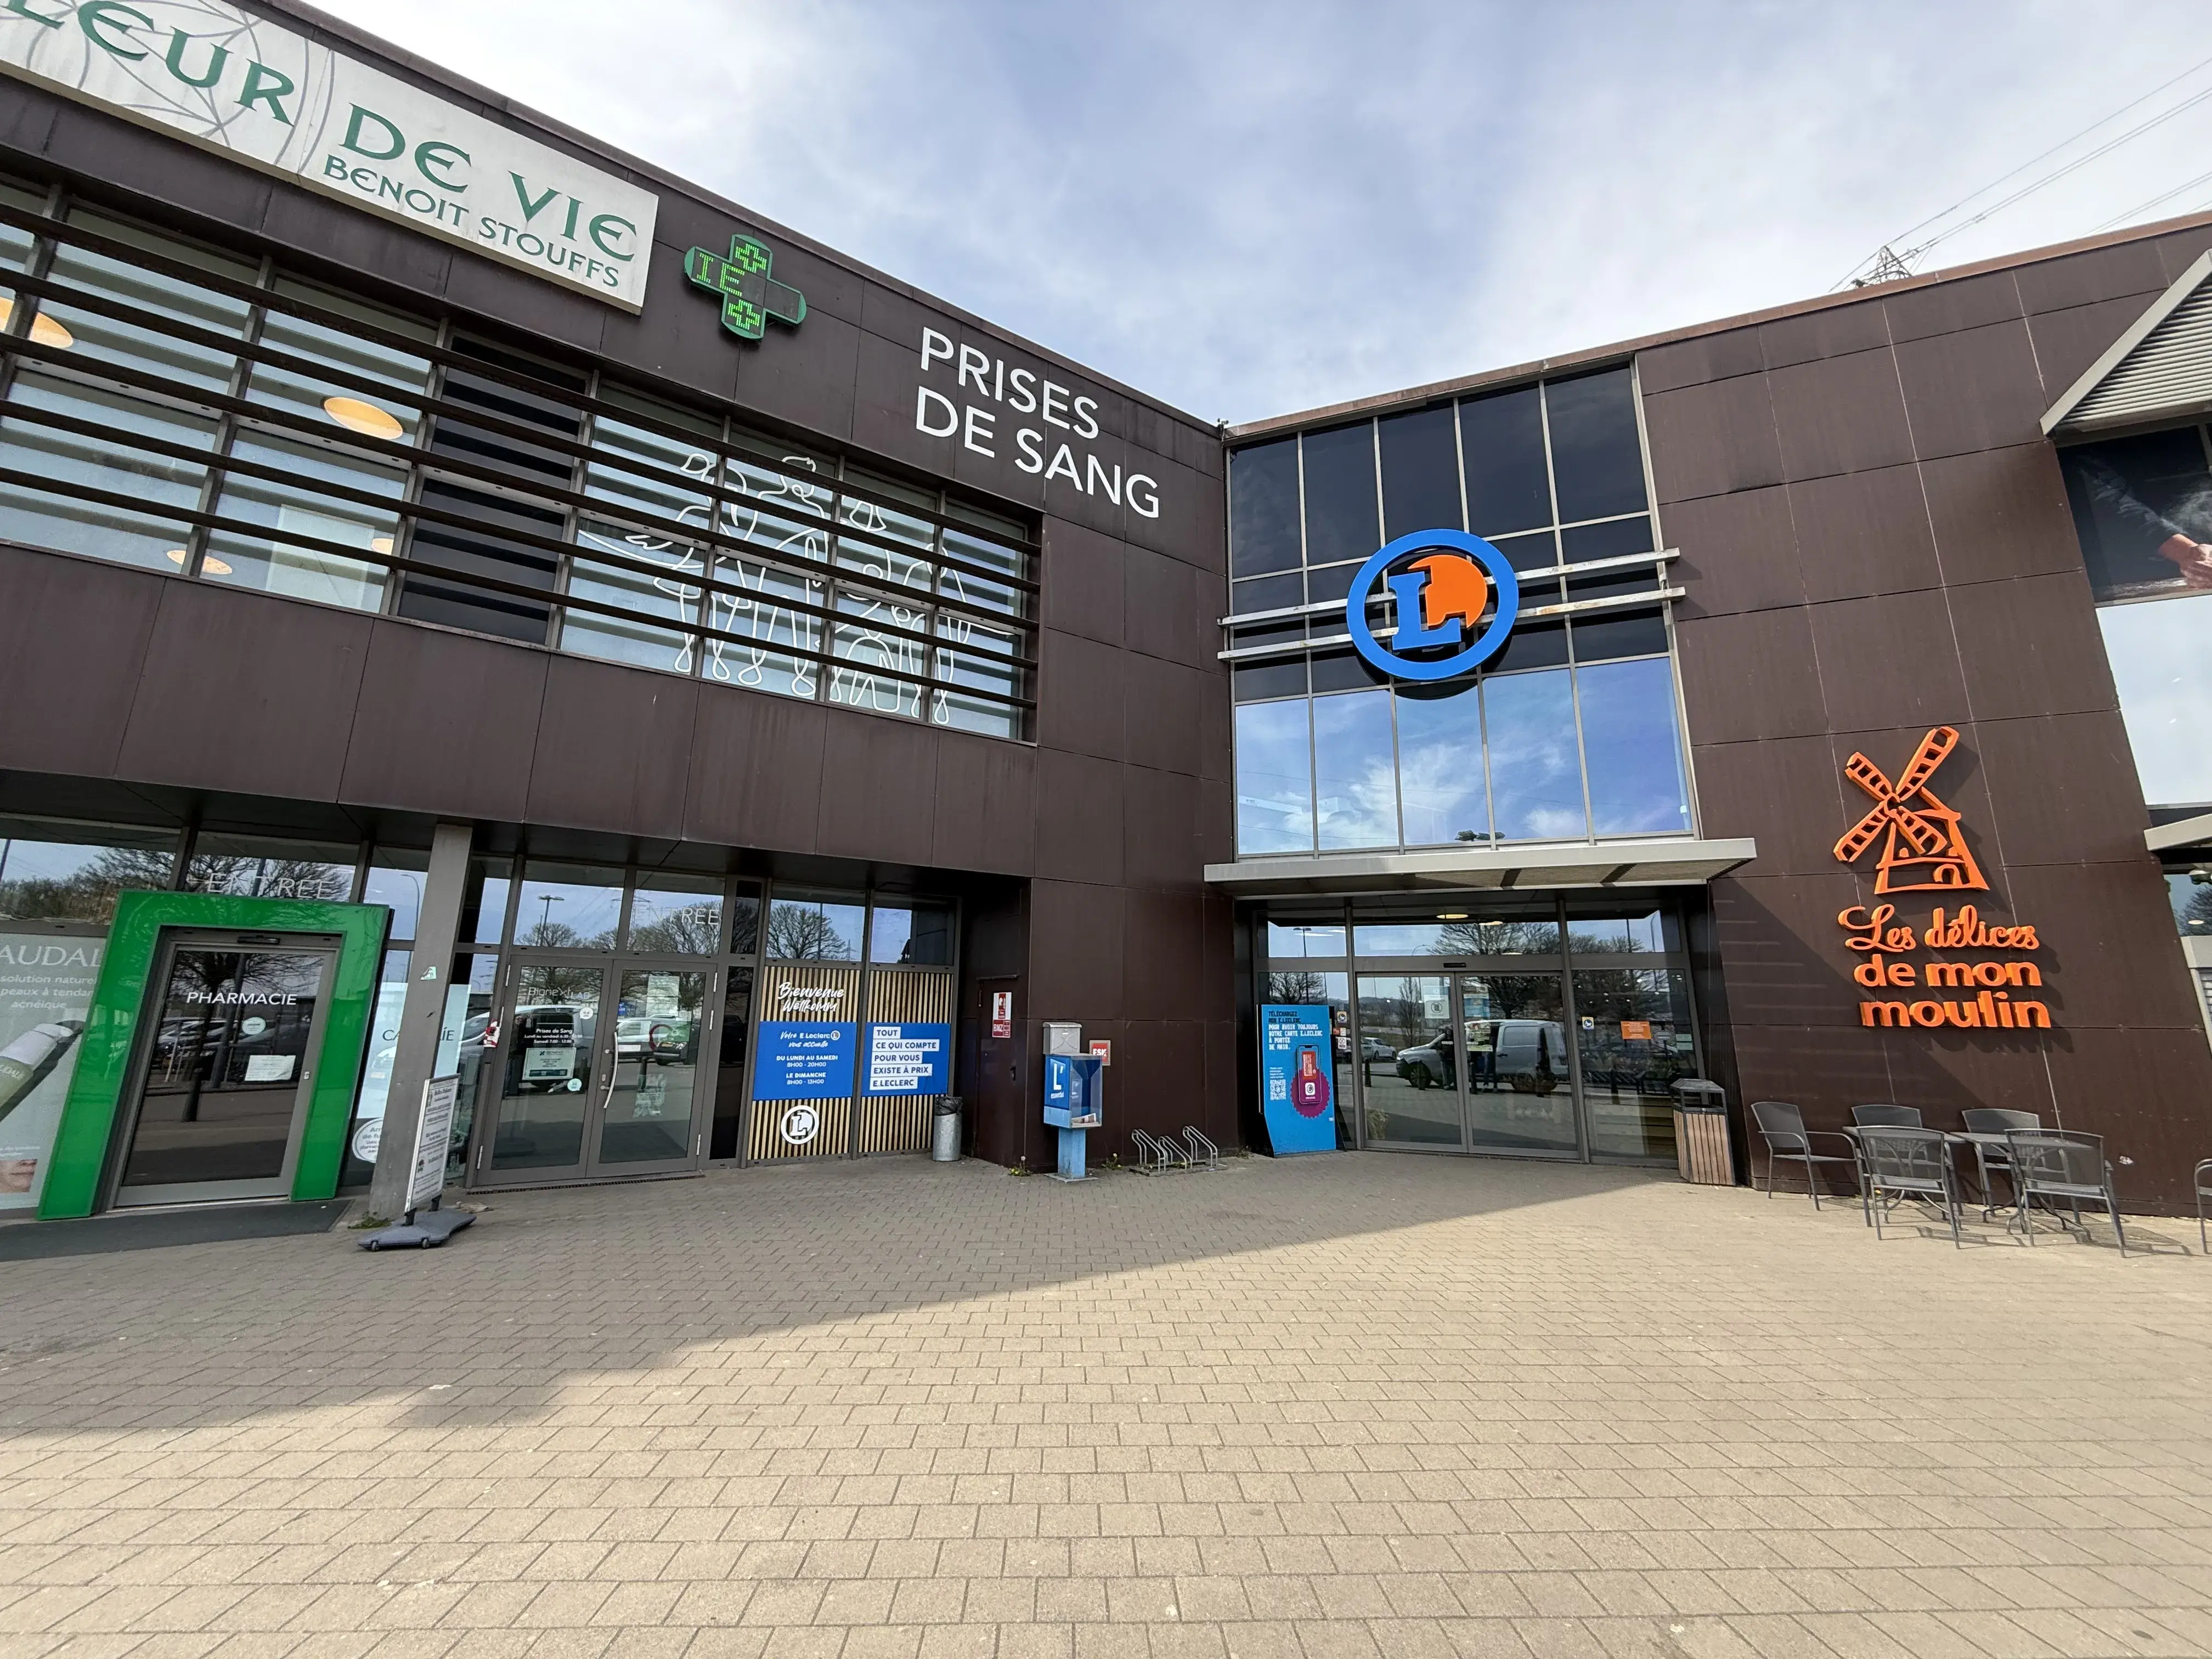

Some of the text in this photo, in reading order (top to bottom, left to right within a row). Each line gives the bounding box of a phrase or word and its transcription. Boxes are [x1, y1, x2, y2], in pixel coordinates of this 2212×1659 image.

[339, 103, 471, 193] DE
[509, 170, 637, 261] VIE
[323, 154, 618, 287] BENOIT STOUFFS
[921, 326, 1098, 439] PRISES
[916, 386, 1159, 518] DE SANG
[1837, 904, 2039, 952] Les délices
[1, 974, 51, 984] solution
[1854, 954, 2041, 987] de mon
[1, 988, 38, 997] peaux
[187, 992, 298, 1005] PHARMACIE
[778, 981, 844, 999] Bienvenue
[1859, 991, 2051, 1028] moulin
